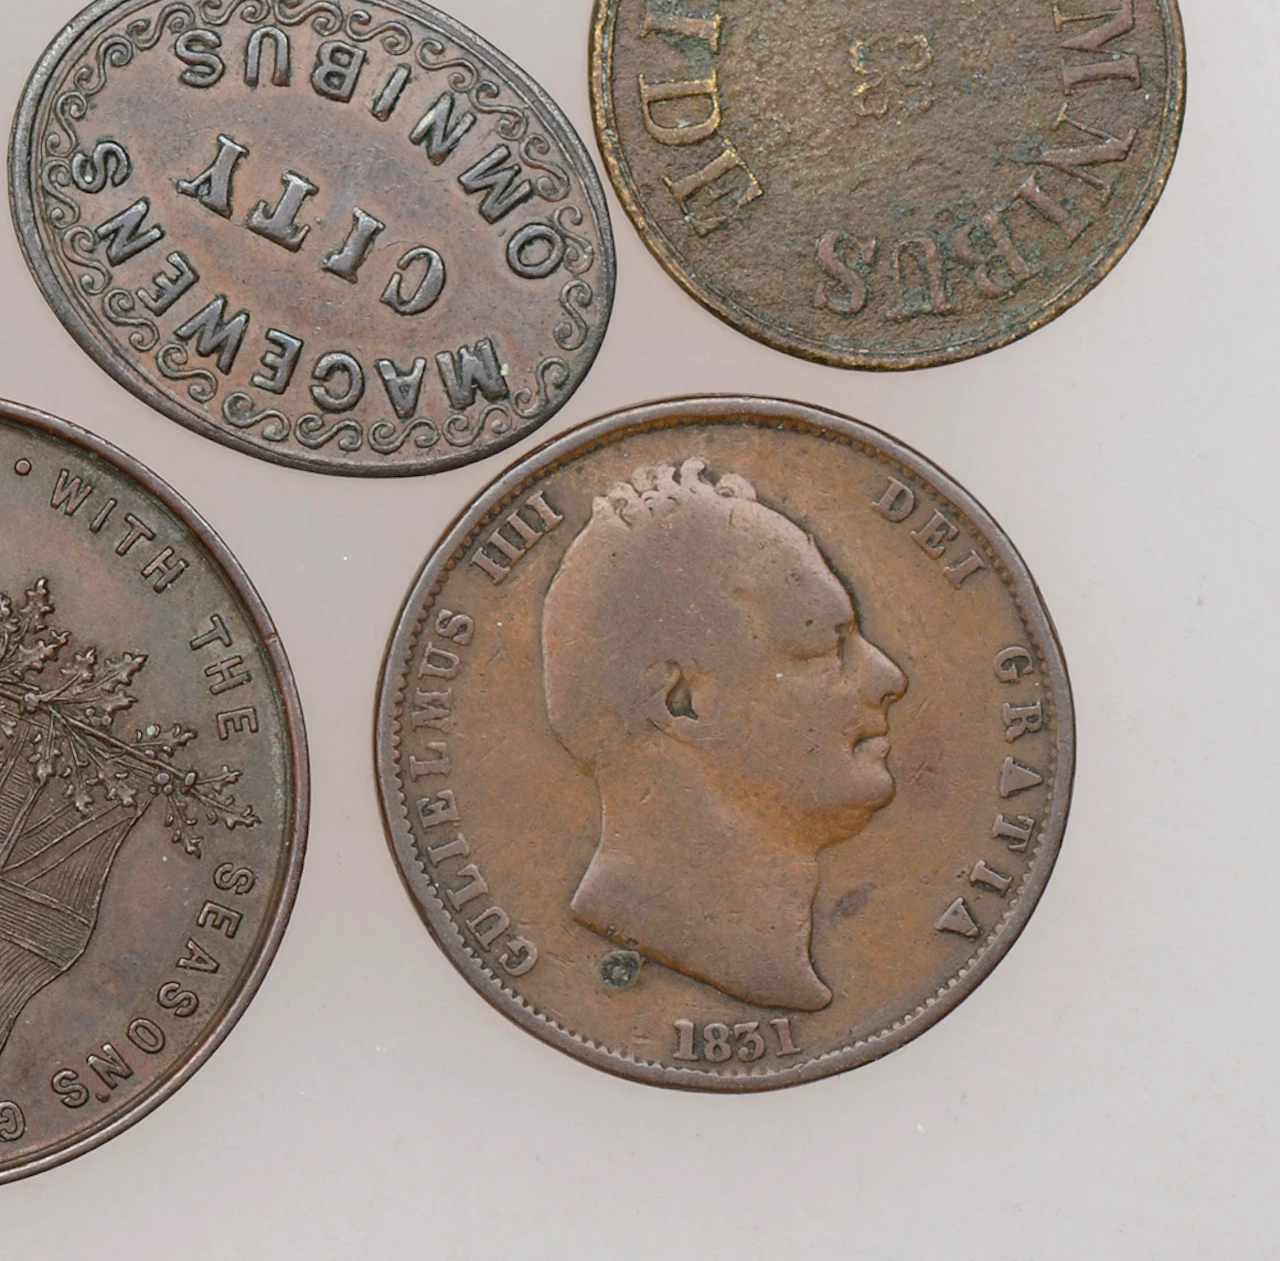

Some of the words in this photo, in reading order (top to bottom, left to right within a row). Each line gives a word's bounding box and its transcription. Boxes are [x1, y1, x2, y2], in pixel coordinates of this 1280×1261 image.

[72, 139, 509, 419] MACEWENS
[175, 26, 565, 280] OMNIBUS
[175, 134, 446, 316] CITY
[48, 468, 193, 595] WITH
[190, 613, 260, 739] THE
[409, 608, 539, 979] GULIELMUS
[871, 476, 989, 590] DEI
[936, 644, 1043, 938] GRATIA
[672, 1016, 802, 1064] 1831
